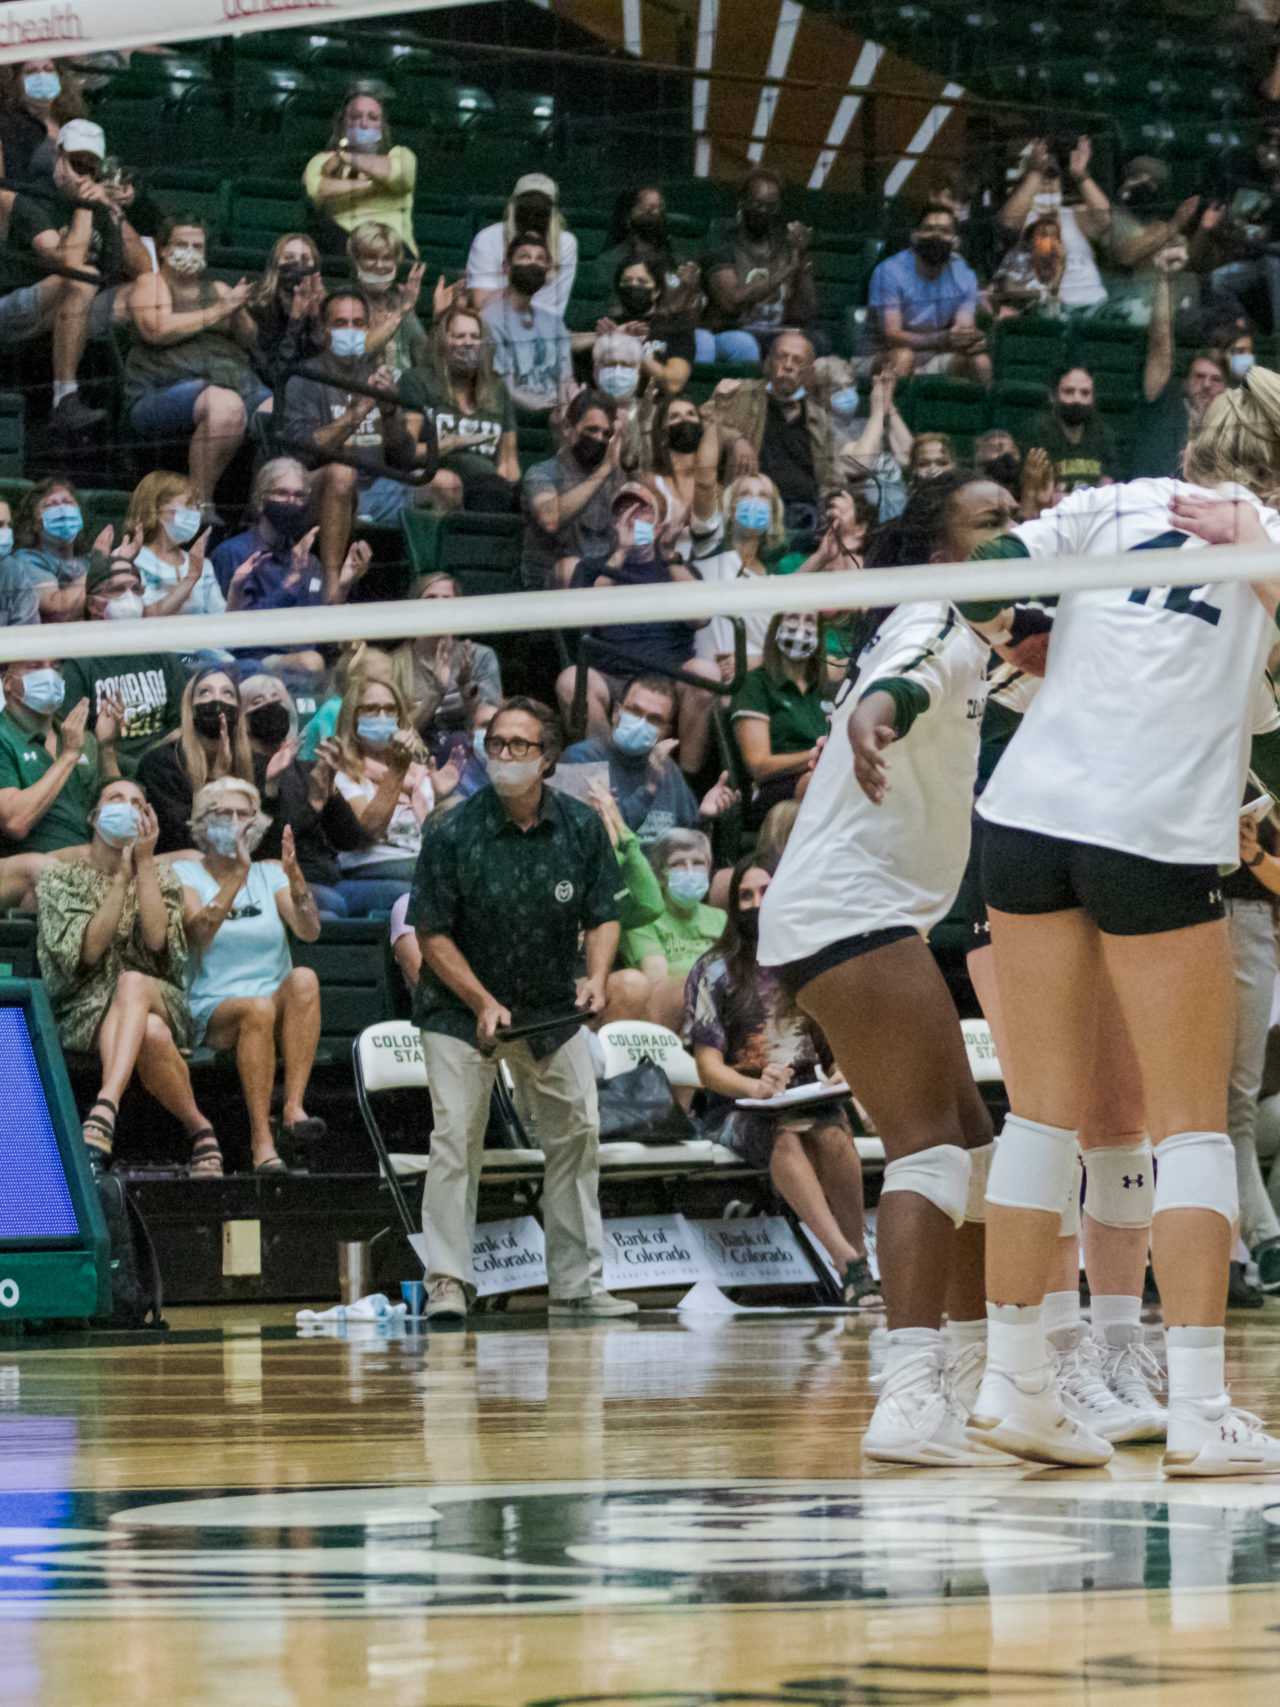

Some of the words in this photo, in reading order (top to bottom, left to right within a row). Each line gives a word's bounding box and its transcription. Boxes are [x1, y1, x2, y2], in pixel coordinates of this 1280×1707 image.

[607, 1033, 678, 1047] COLORADO
[472, 1233, 500, 1255] ank
[611, 1227, 650, 1248] Bank
[653, 1227, 668, 1245] of
[719, 1230, 755, 1248] Bank
[623, 1245, 691, 1265] Colorado
[729, 1247, 793, 1266] Colorado
